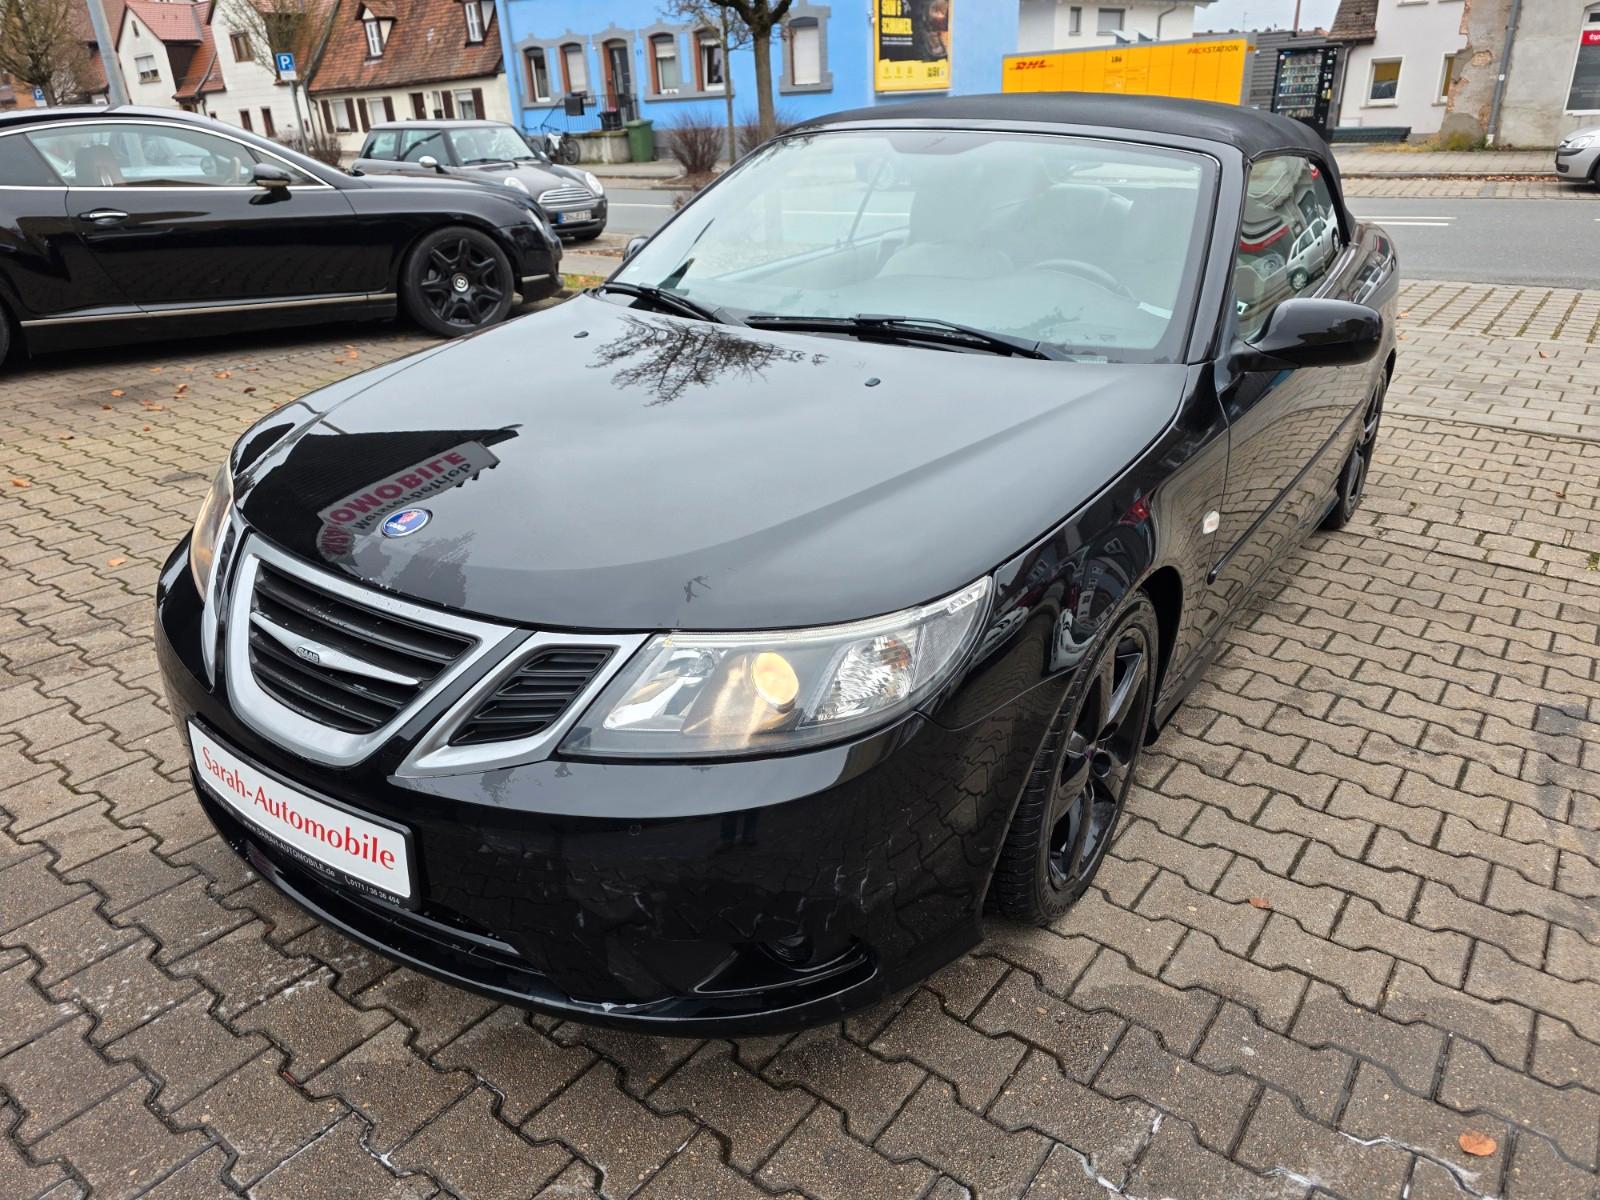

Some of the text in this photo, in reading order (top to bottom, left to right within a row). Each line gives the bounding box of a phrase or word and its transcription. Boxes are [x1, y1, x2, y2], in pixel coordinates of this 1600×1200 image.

[1187, 45, 1239, 54] PACKSTATION
[281, 55, 290, 69] P
[1015, 60, 1047, 70] DHL
[203, 746, 394, 870] Sarah-Automobile
